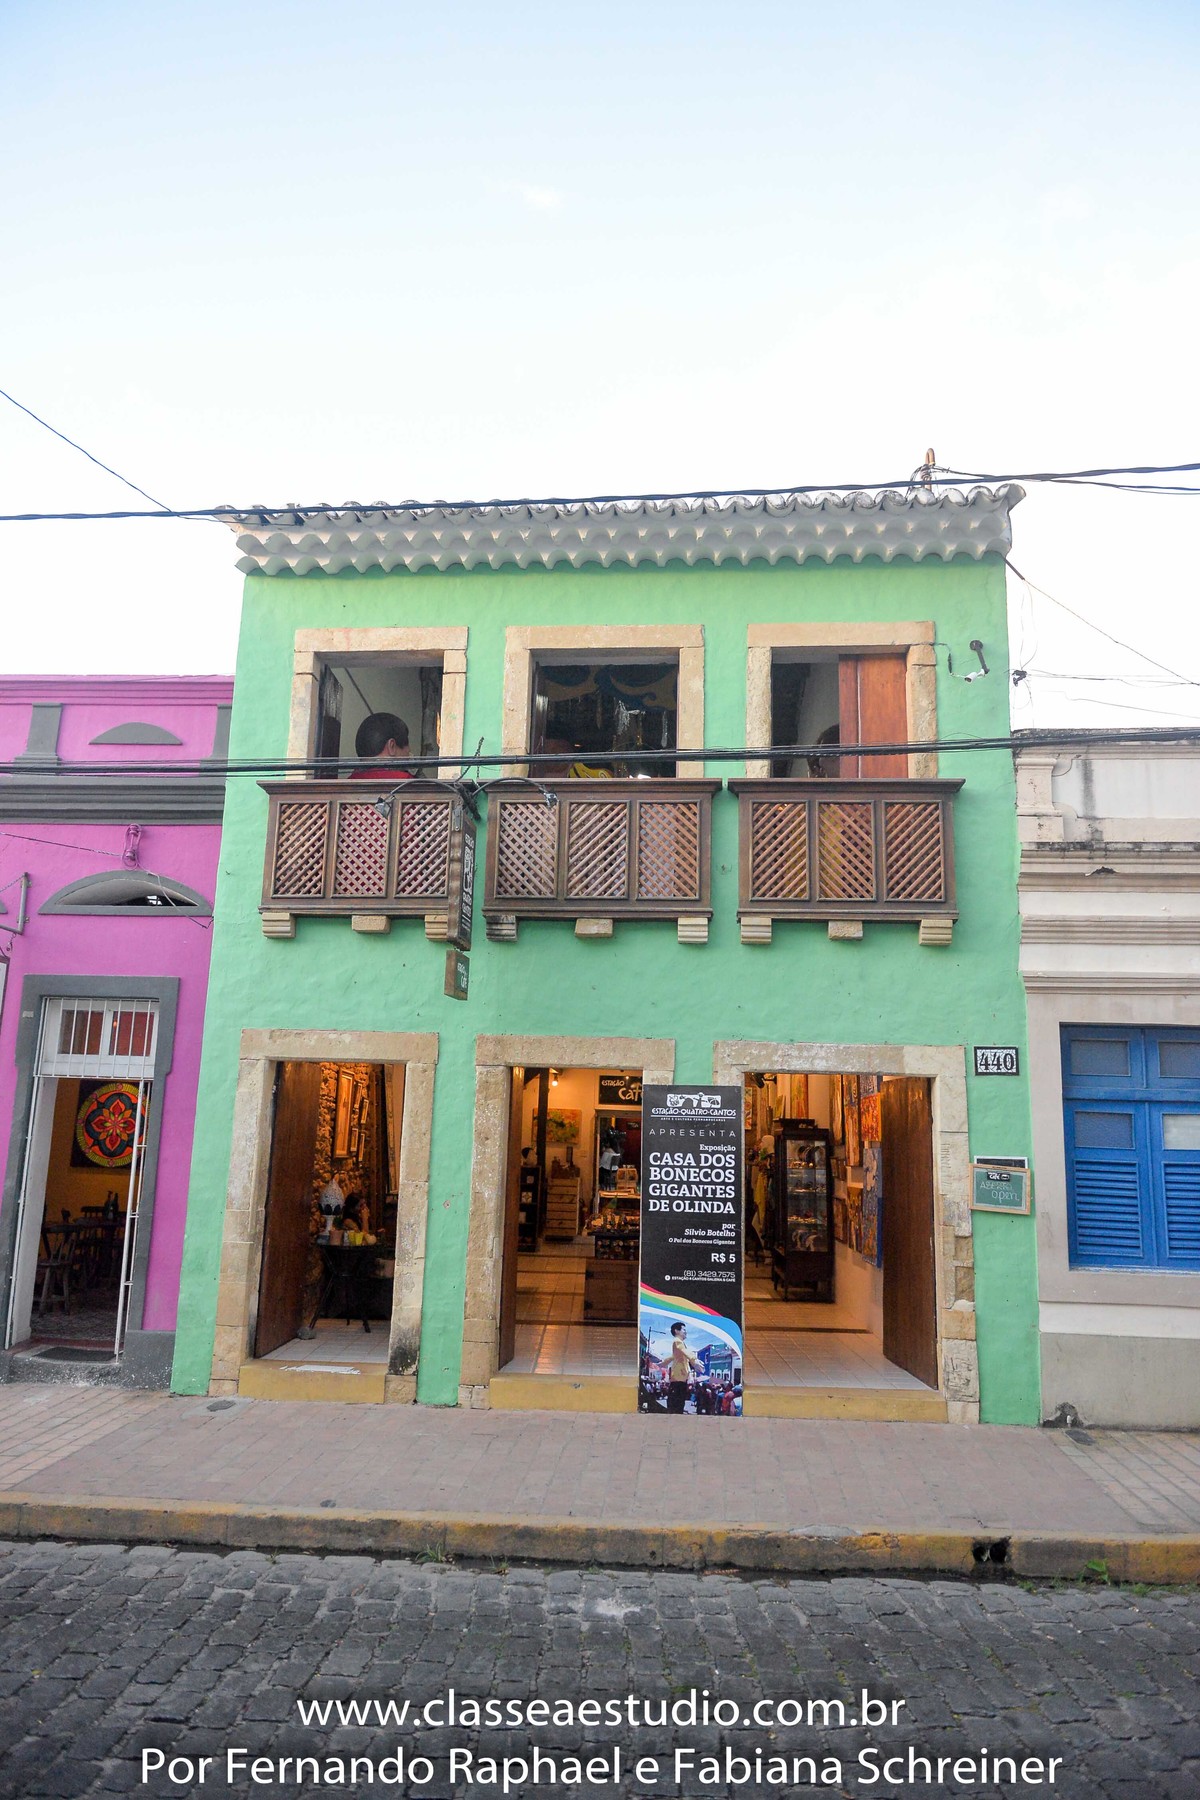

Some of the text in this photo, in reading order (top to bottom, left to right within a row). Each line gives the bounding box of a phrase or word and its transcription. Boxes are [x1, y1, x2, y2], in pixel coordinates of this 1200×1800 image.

[979, 1051, 1015, 1071] 440
[649, 1128, 736, 1138] APRESENTA
[699, 1143, 736, 1153] Exposição
[649, 1152, 736, 1167] CASA DOS
[649, 1166, 736, 1183] BONECOS
[648, 1183, 736, 1198] GIGANTES
[648, 1199, 736, 1214] DE OLINDA
[706, 1229, 736, 1237] Botelho
[711, 1252, 736, 1264] R$ 5
[697, 1270, 736, 1279] 3429.7575
